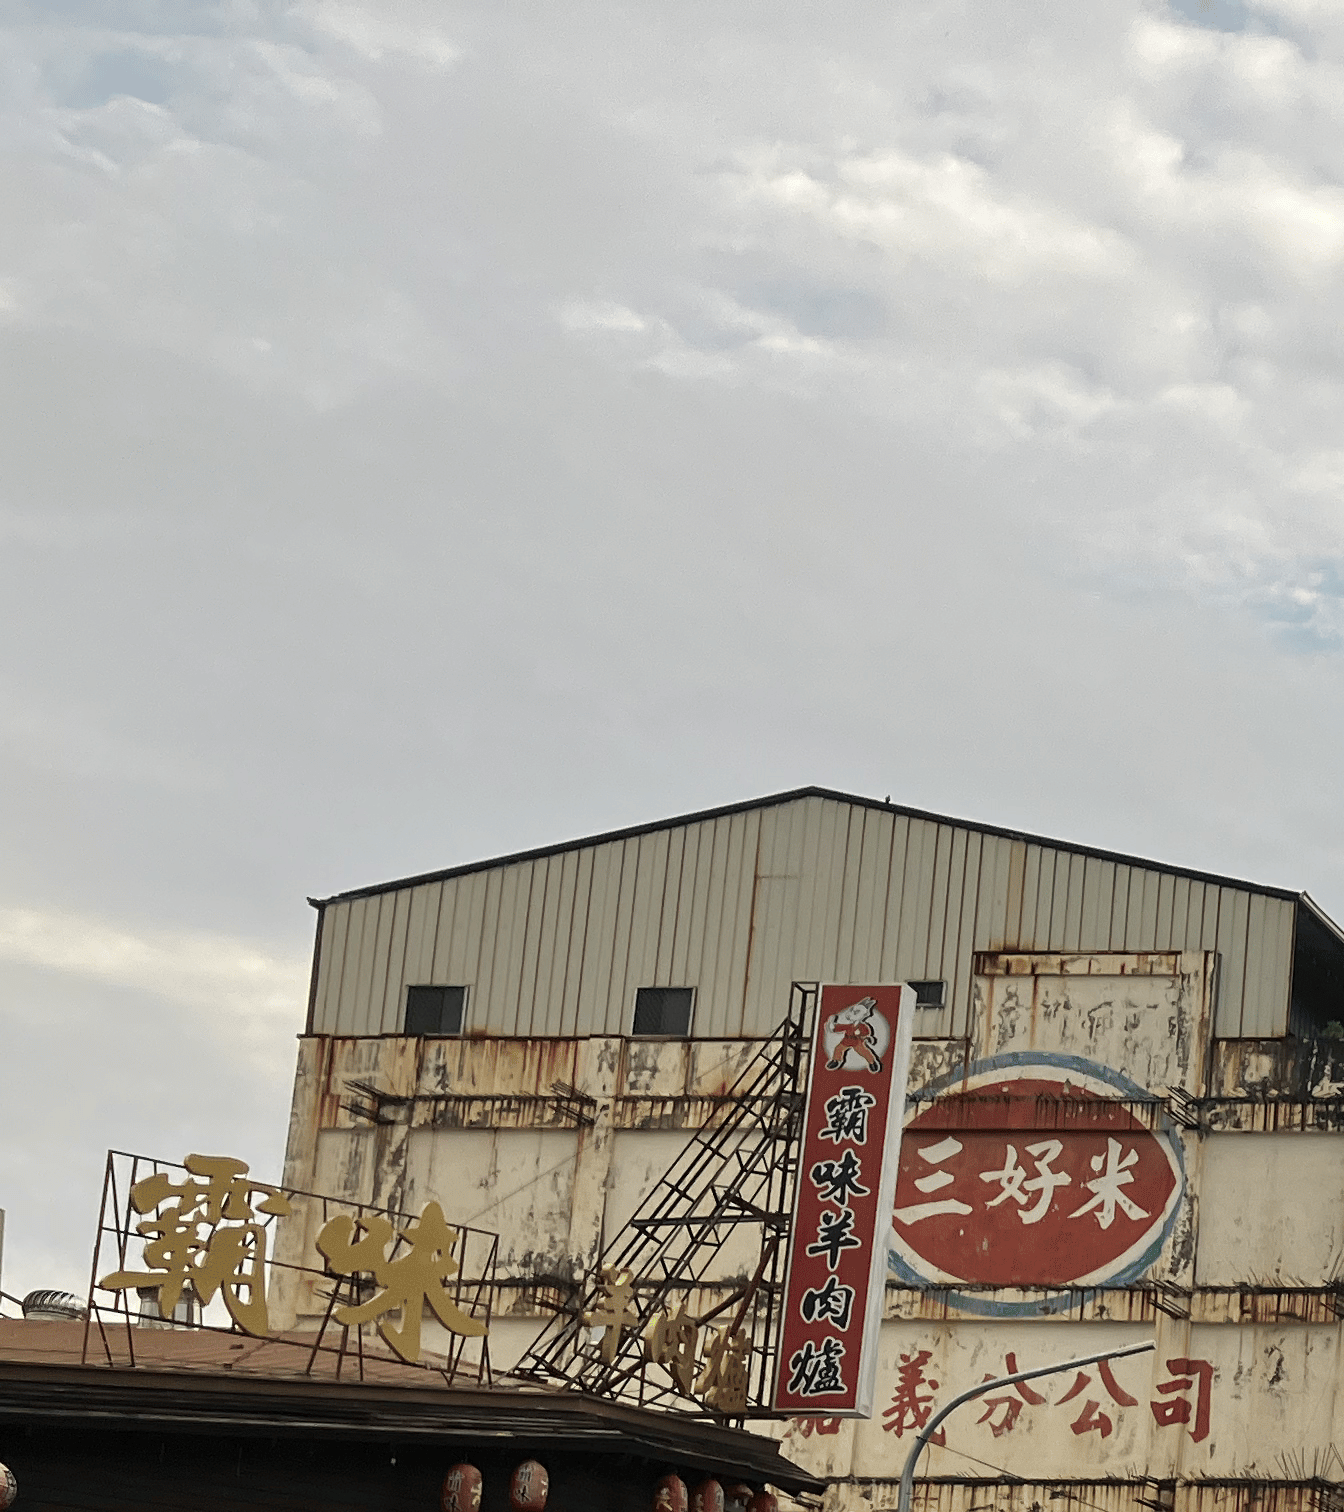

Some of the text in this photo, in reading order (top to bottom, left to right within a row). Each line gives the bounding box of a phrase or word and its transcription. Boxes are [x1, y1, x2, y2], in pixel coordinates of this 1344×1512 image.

[98, 1152, 489, 1363] 霸味
[788, 1086, 872, 1396] 霸味羊肉爐
[893, 1134, 1152, 1230] 三好米
